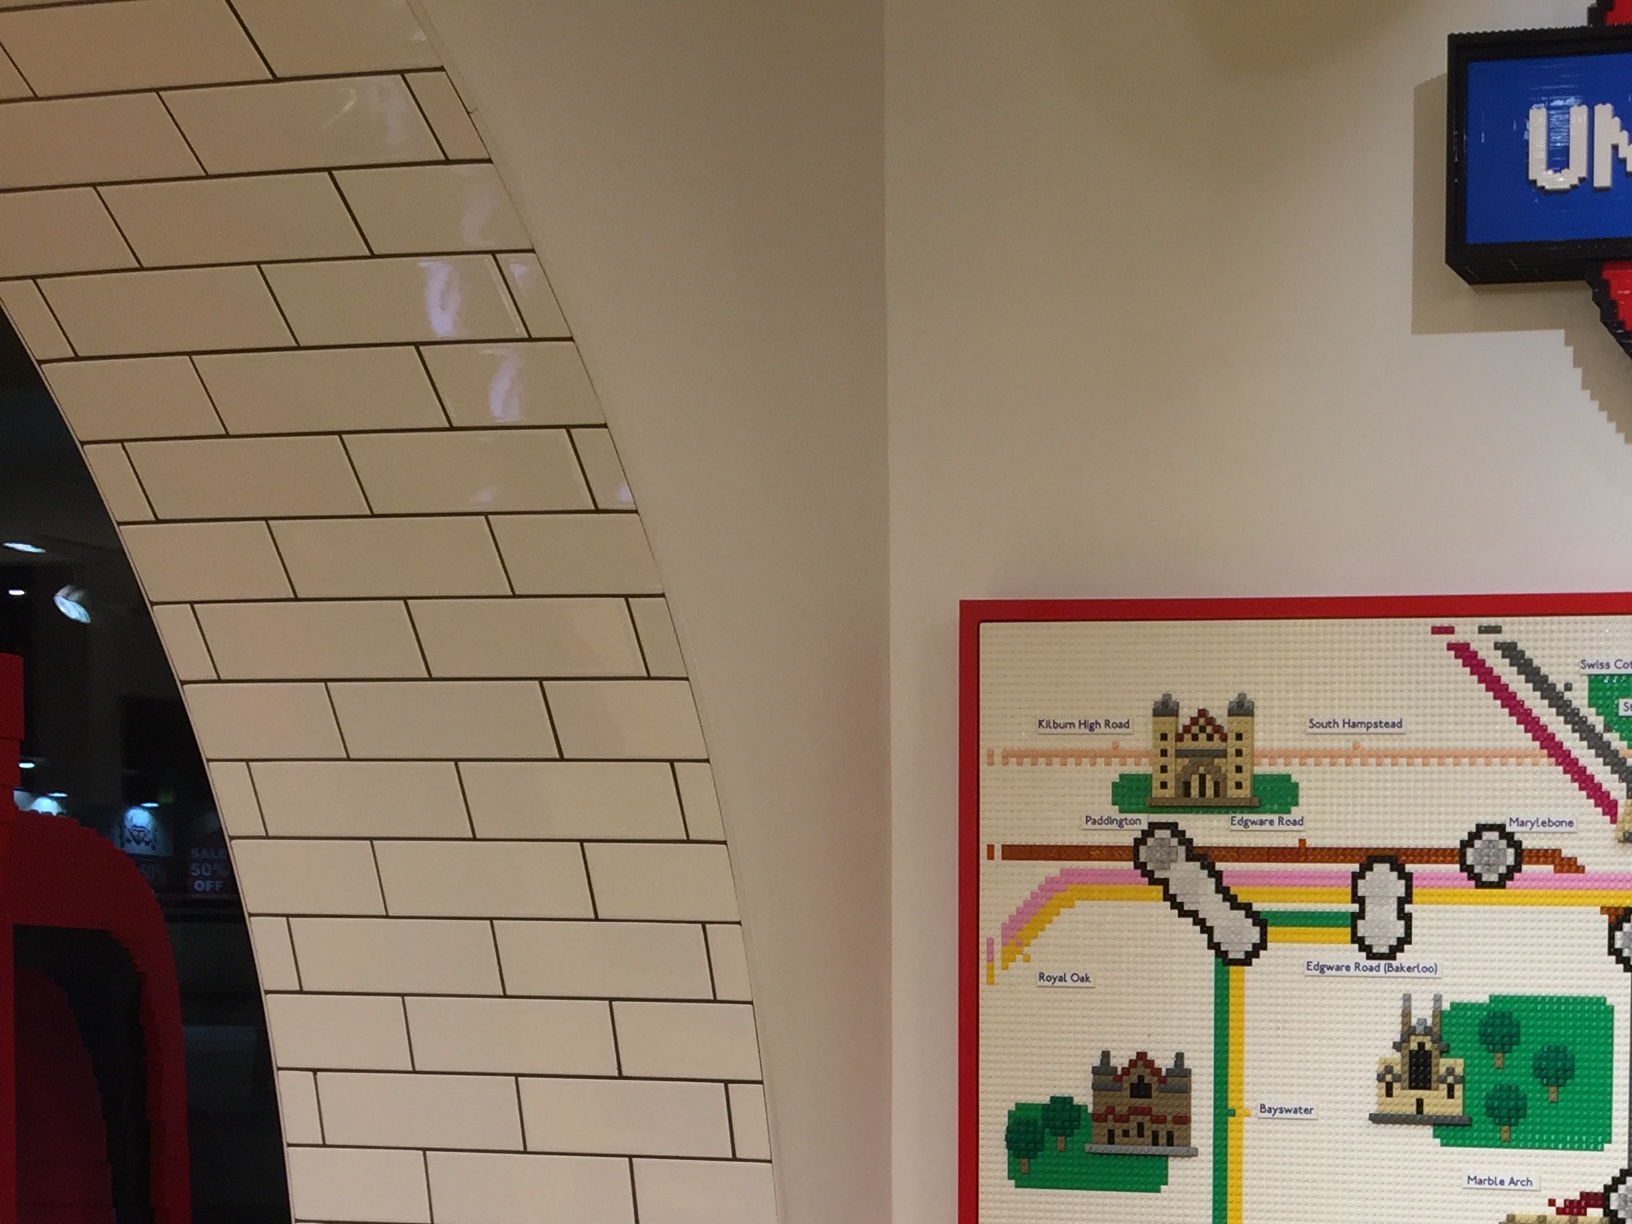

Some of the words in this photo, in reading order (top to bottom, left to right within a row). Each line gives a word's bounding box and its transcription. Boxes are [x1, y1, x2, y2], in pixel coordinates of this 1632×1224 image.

[1580, 659, 1610, 670] Swiss
[1038, 719, 1075, 730] Kilburn
[1078, 719, 1101, 732] High
[1104, 719, 1130, 730] Road
[1309, 719, 1338, 729] South
[1341, 719, 1403, 732] Hampstead
[1085, 816, 1141, 828] Paddington
[1230, 816, 1274, 829] Edgware
[1278, 816, 1304, 827] Road
[1509, 817, 1574, 830] Marylebone
[191, 848, 227, 859] SALE
[194, 880, 223, 892] OFF
[1306, 962, 1350, 975] Edgware
[1354, 962, 1380, 973] Road
[1384, 963, 1438, 975] (Bakerloo)
[1038, 973, 1067, 985] Royal
[1070, 973, 1091, 983] Oak
[1260, 1104, 1314, 1117] Bayswater
[1467, 1175, 1504, 1187] Marble
[1508, 1176, 1533, 1188] Arch
